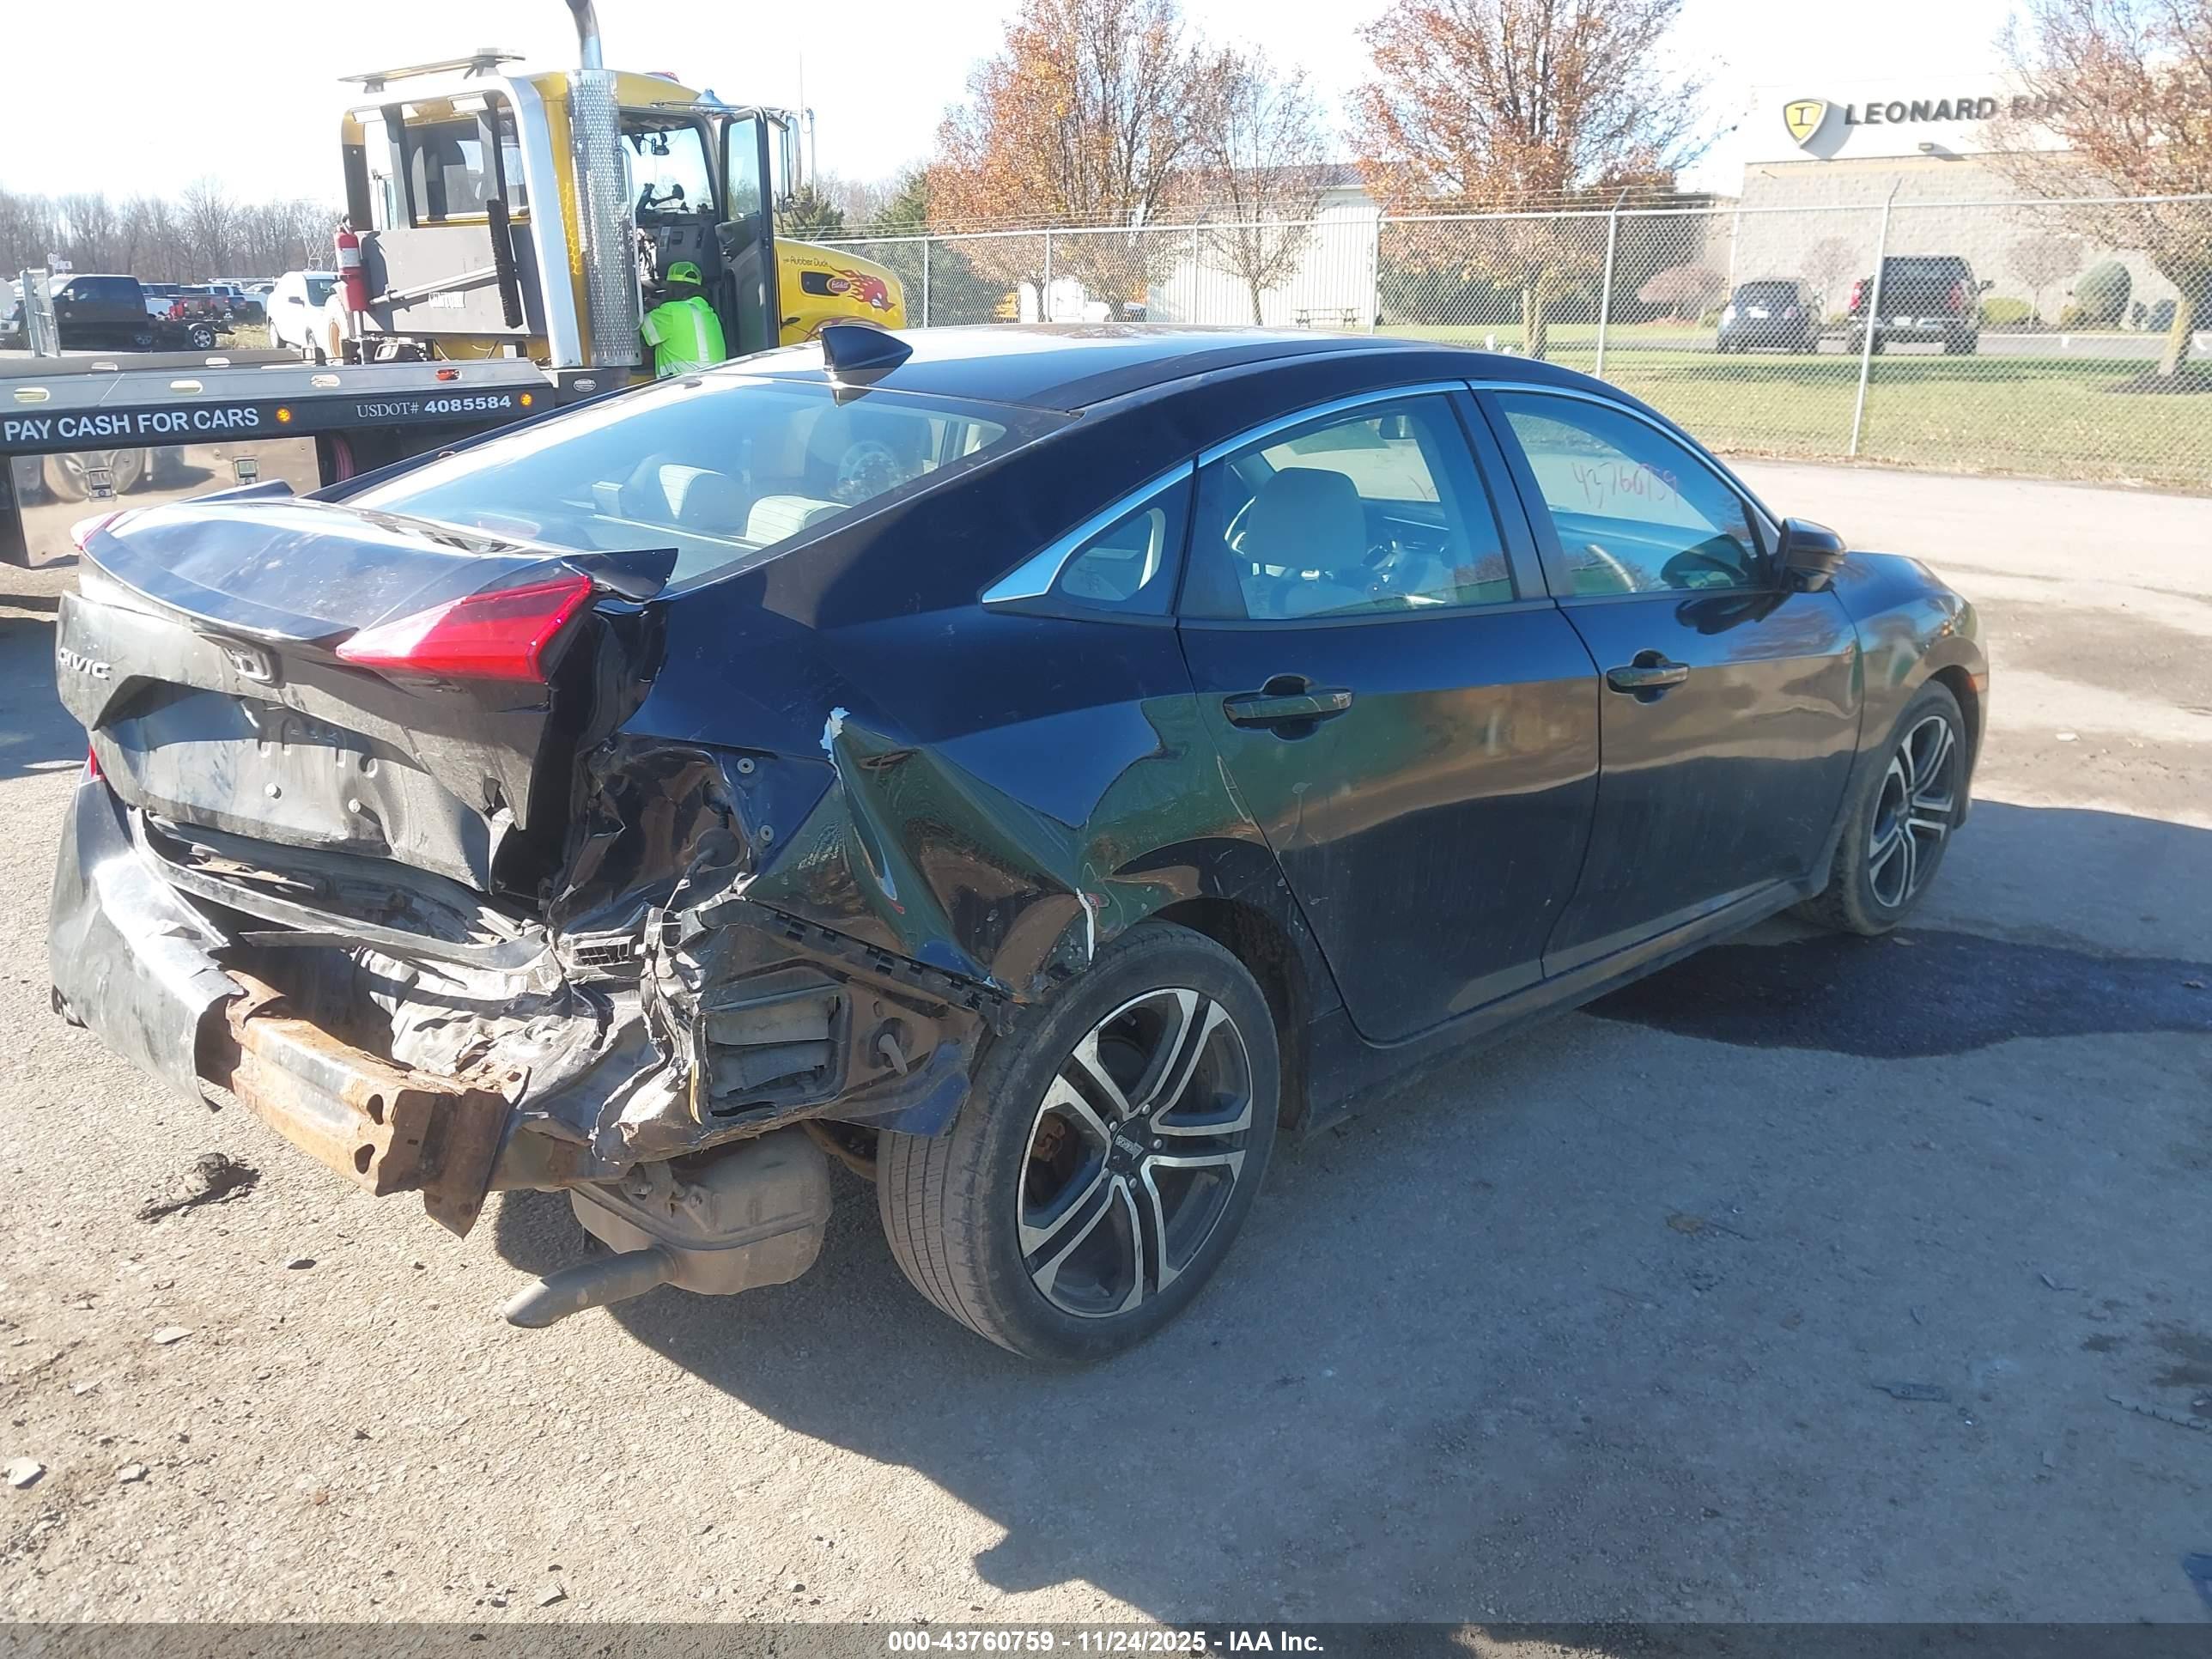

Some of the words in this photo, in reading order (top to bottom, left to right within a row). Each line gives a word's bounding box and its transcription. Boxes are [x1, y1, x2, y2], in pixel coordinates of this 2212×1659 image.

[1844, 96, 1997, 125] LEONARD
[790, 255, 812, 266] Rubber
[356, 402, 419, 417] USDOT#
[424, 395, 511, 413] 4085584
[4, 419, 52, 441] PAY
[58, 414, 131, 437] CASH
[137, 411, 189, 433] FOR
[193, 407, 259, 429] CARS
[58, 647, 111, 680] CIVIC
